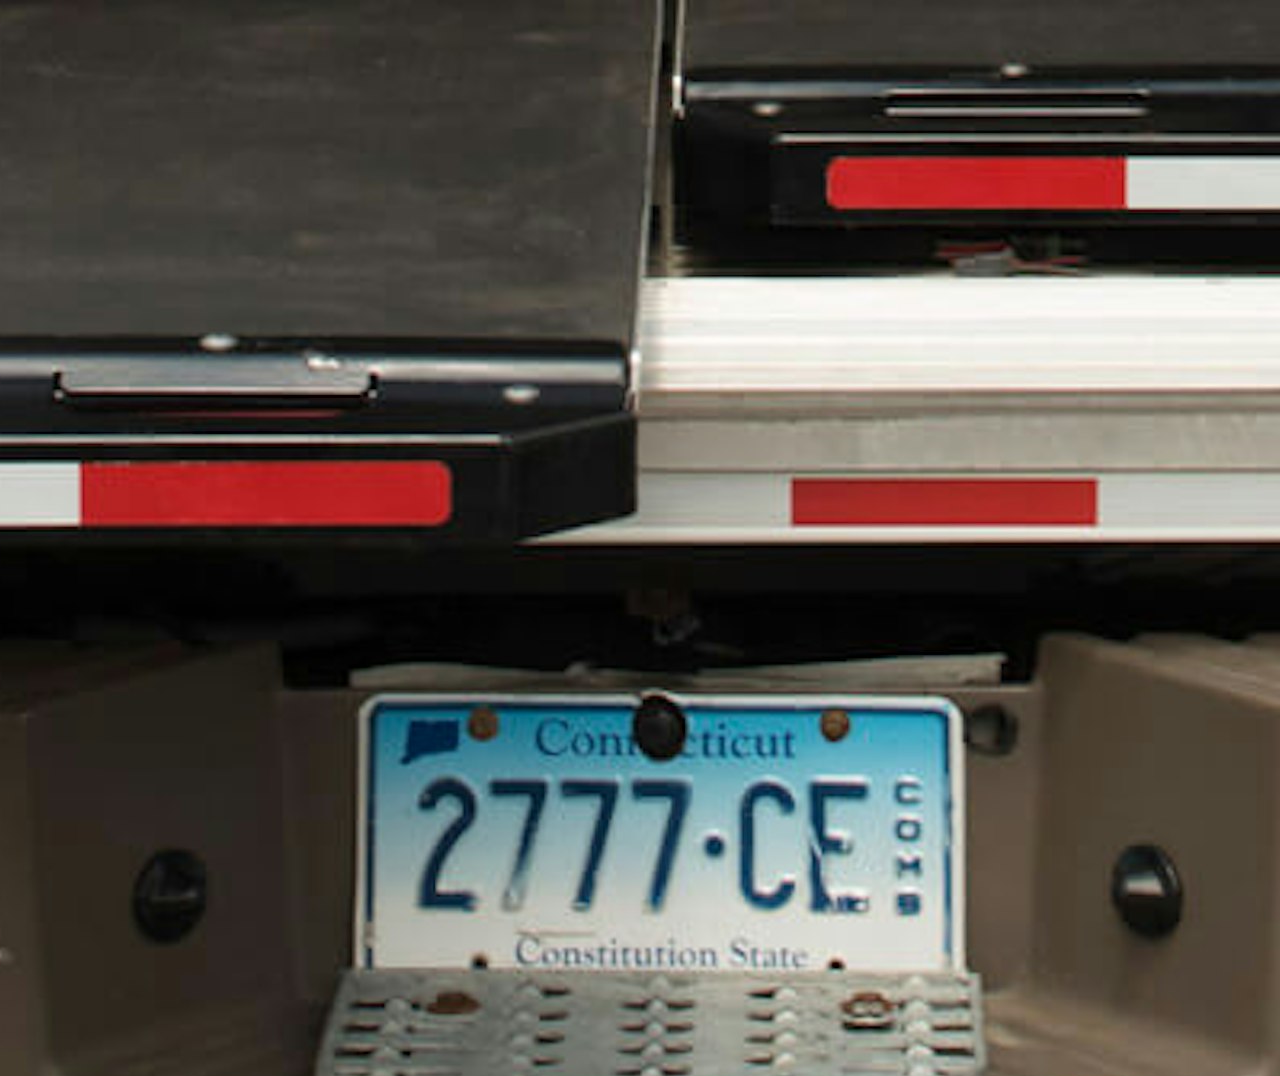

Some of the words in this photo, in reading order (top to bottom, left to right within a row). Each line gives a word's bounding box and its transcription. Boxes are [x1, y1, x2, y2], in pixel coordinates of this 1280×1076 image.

[535, 716, 796, 759] Conticut
[515, 936, 718, 967] Constitution
[729, 937, 810, 968] State
